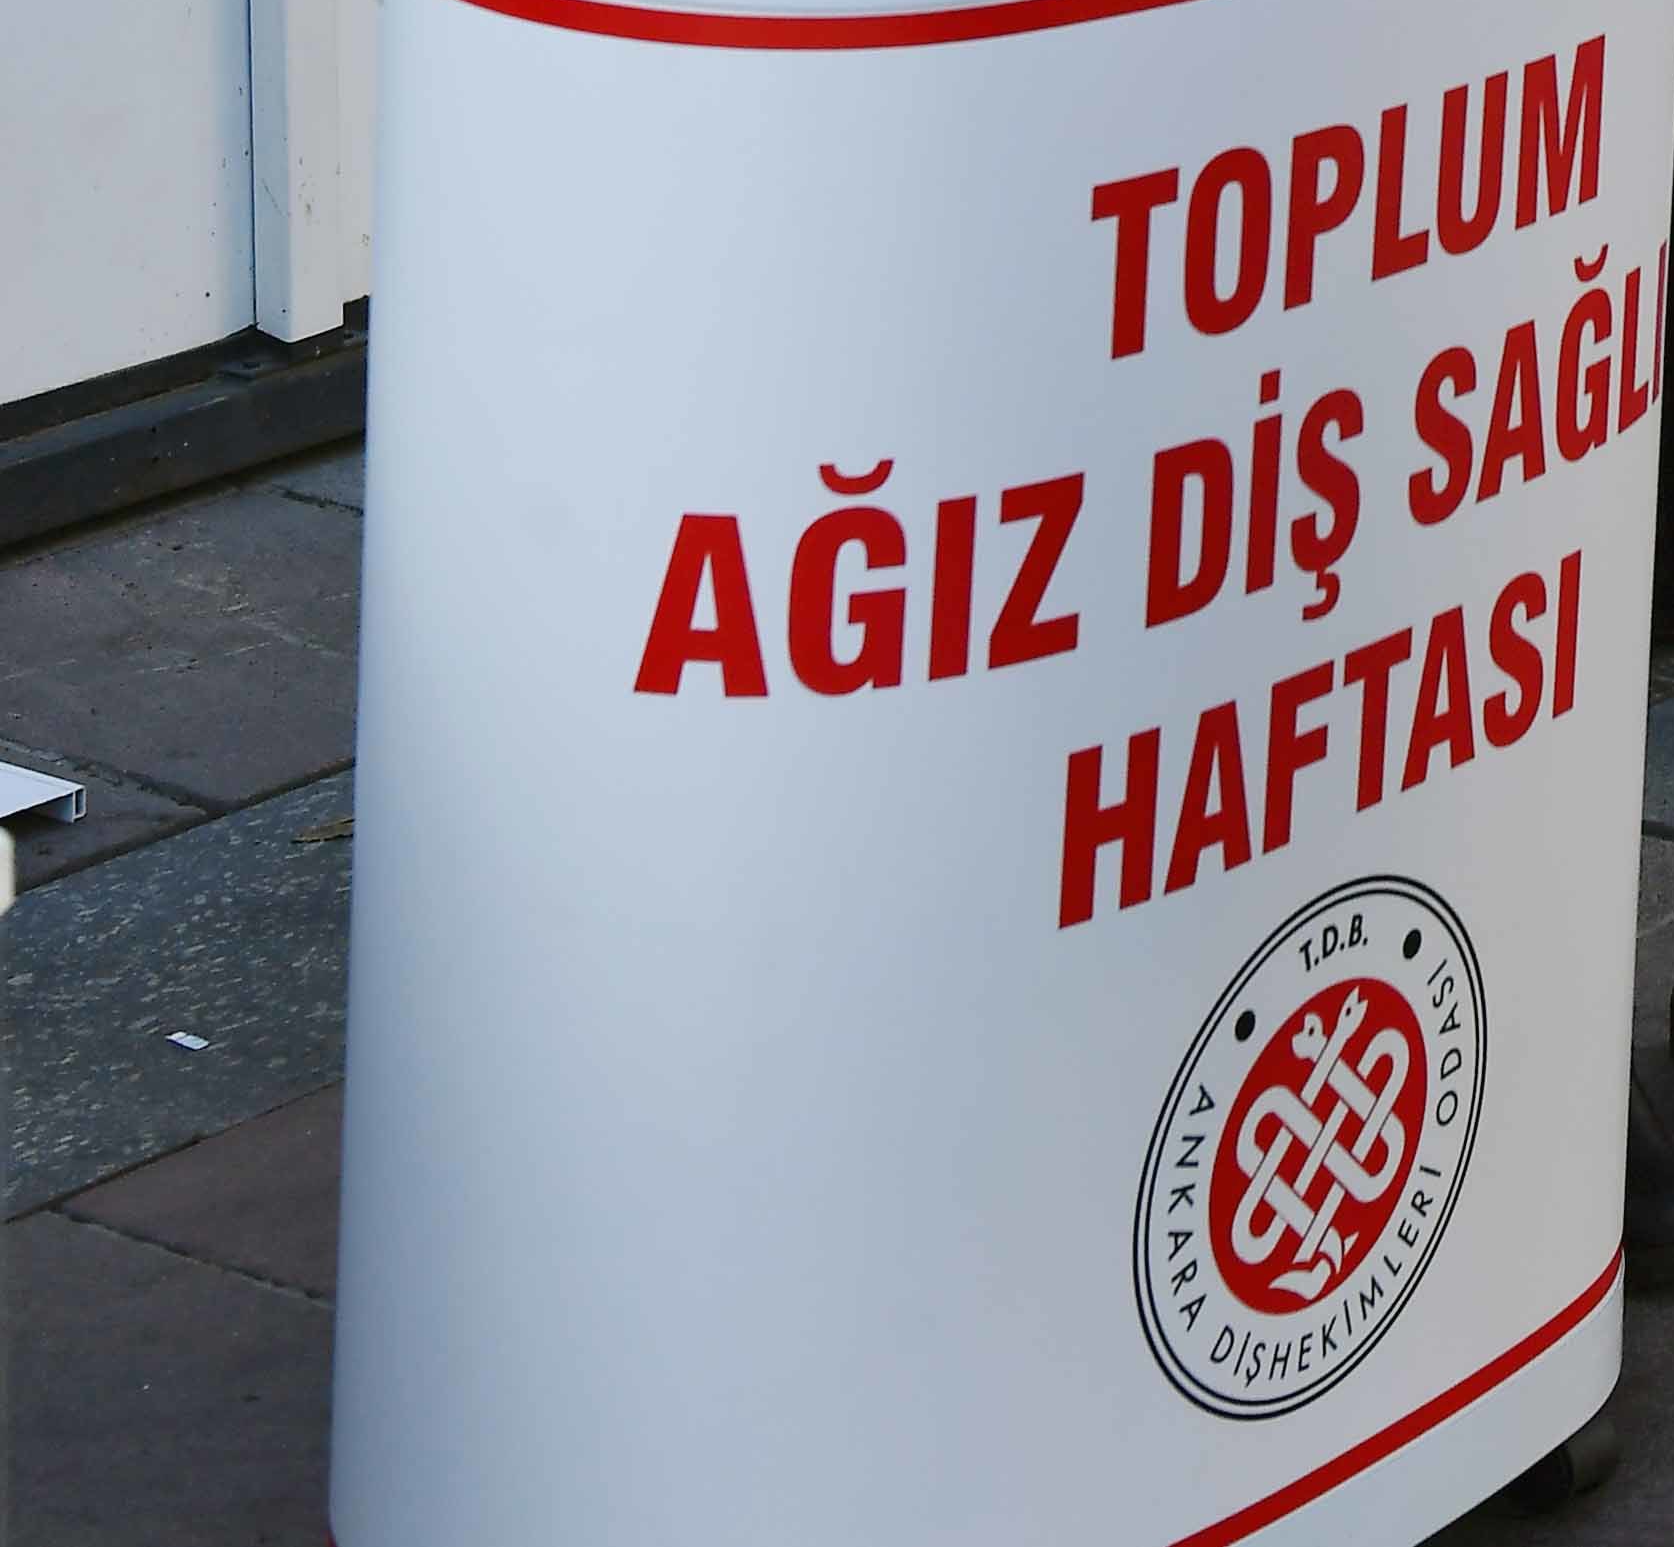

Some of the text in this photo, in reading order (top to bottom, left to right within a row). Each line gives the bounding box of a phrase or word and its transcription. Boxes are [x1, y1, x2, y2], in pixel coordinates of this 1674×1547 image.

[1089, 33, 1606, 361] TOPLUM
[632, 238, 1668, 699] AĞIZ DİŞ SAĞLI
[1057, 549, 1583, 930] HAFTASI
[1299, 912, 1369, 972] T.D.B.
[1167, 1084, 1216, 1332] ANKARA
[1426, 957, 1463, 1127] ODASI
